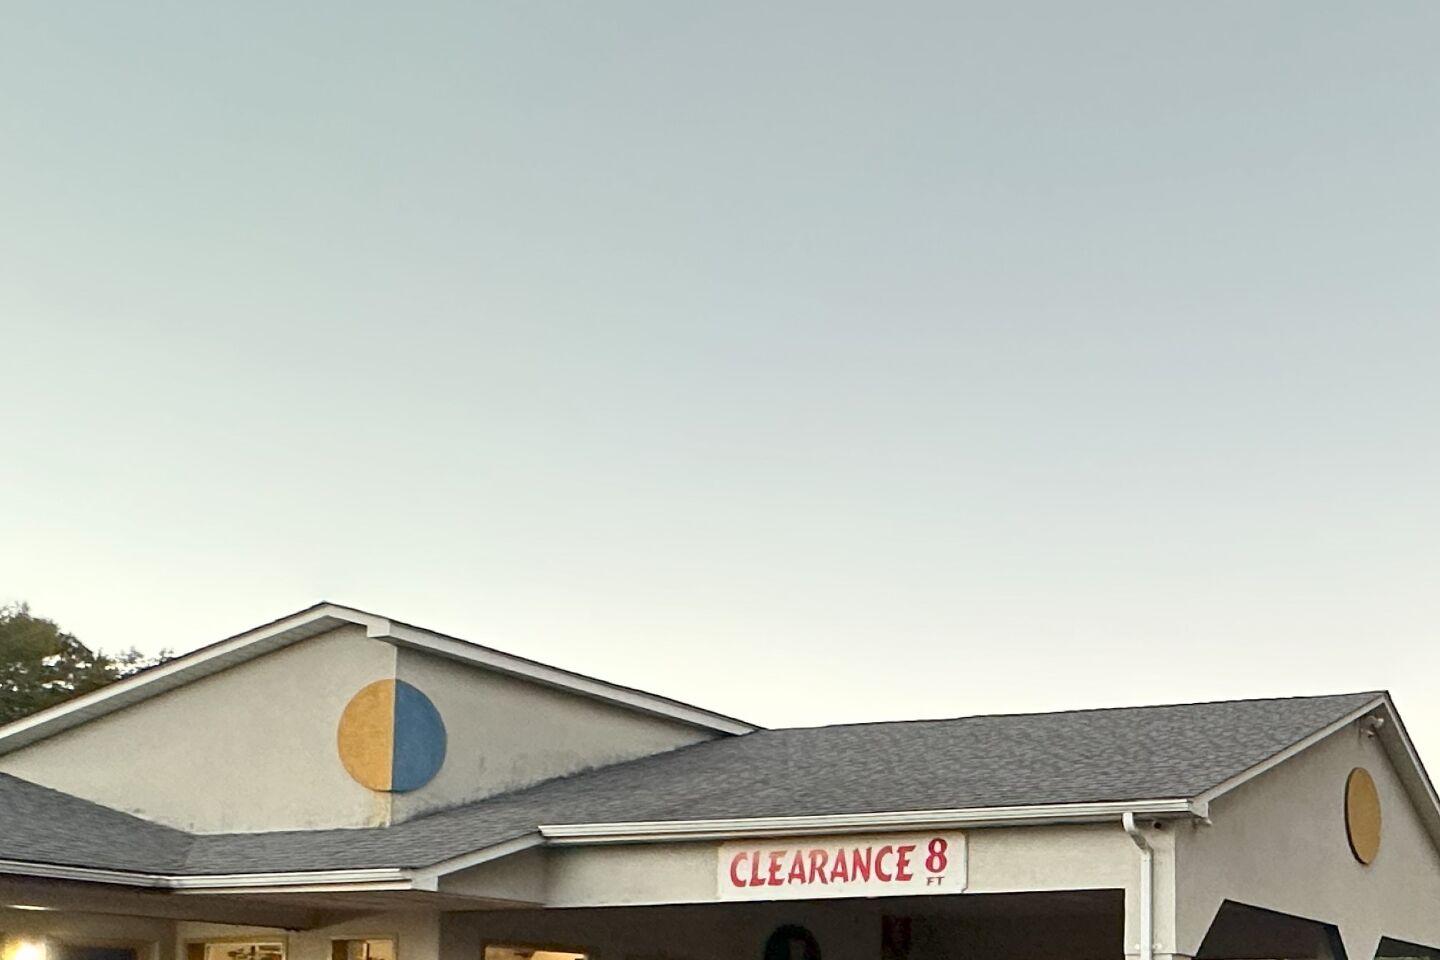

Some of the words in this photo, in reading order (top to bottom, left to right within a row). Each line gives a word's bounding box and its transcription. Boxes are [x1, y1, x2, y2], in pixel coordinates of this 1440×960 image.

[730, 845, 916, 887] CLEARANCE
[925, 837, 948, 873] 8
[926, 876, 945, 886] FT
